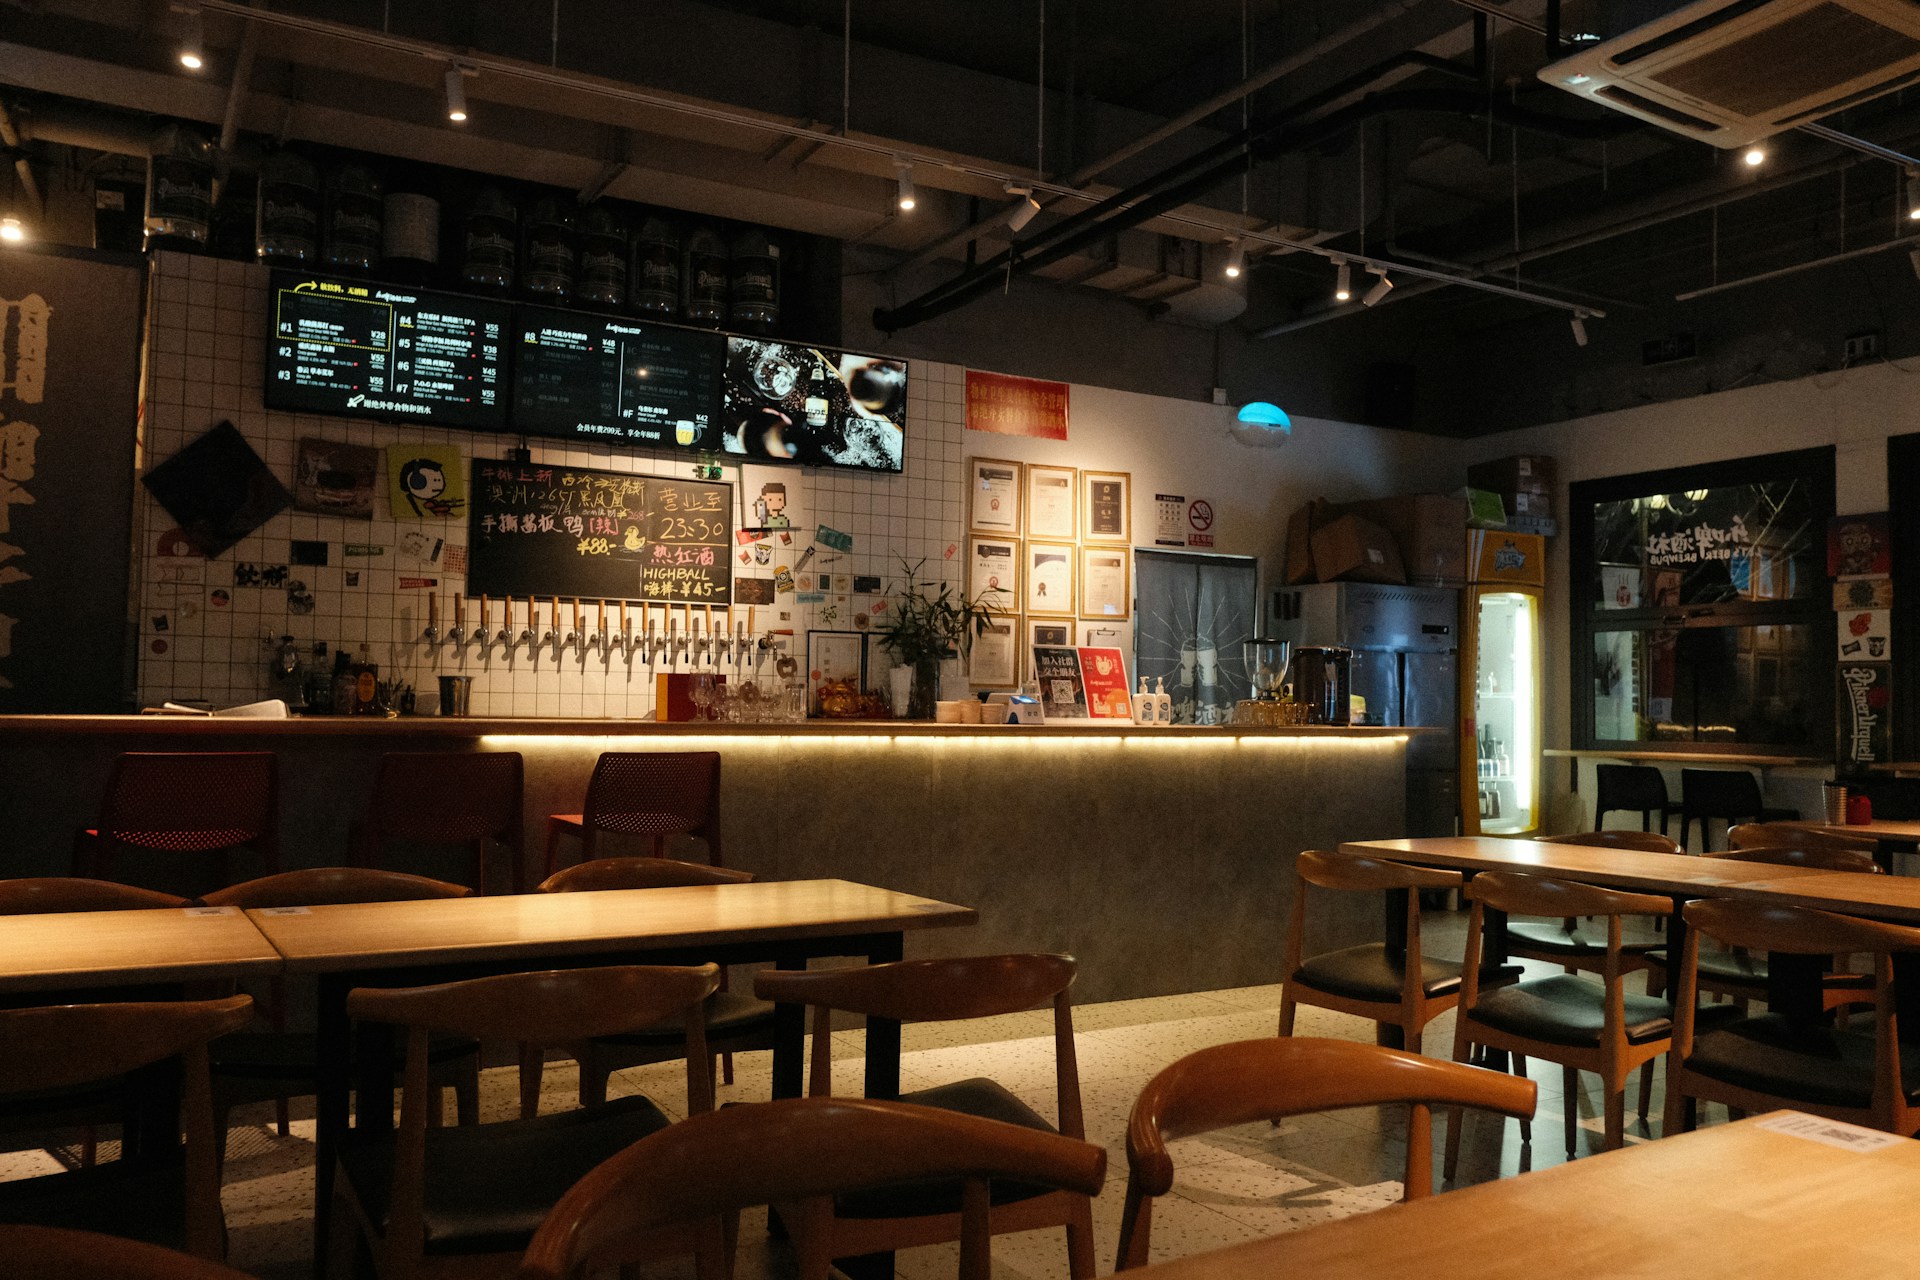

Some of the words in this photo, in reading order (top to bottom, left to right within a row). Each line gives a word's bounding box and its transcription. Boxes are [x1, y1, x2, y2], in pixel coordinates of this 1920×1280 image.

[399, 316, 411, 325] #4
[280, 322, 292, 333] #1
[485, 323, 499, 332] ¥55
[371, 330, 386, 340] ¥28
[525, 332, 536, 341] #8
[398, 338, 410, 348] #5
[602, 338, 616, 347] ¥48
[279, 346, 292, 357] #2
[483, 345, 498, 354] ¥38
[371, 353, 385, 362] ¥55
[397, 361, 410, 371] #6
[278, 370, 291, 380] #3
[482, 367, 496, 376] ¥45
[369, 376, 384, 385] ¥55
[396, 383, 408, 393] #7
[482, 389, 496, 398] ¥55
[363, 399, 432, 415] 谢绝外带食物和酒水
[623, 409, 634, 418] #F
[695, 414, 709, 422] ¥42
[627, 428, 661, 441] 享全年88折
[482, 468, 554, 488] 牛排上新
[658, 487, 722, 511] 营业至
[660, 517, 724, 540] 23:30
[651, 545, 715, 566] 热红酒
[644, 567, 710, 581] HIGHBALL
[1041, 656, 1075, 666] 加入社群
[1042, 667, 1076, 678] 交个朋友
[1842, 667, 1877, 716] Pilsner
[1851, 714, 1878, 761] Urquell
